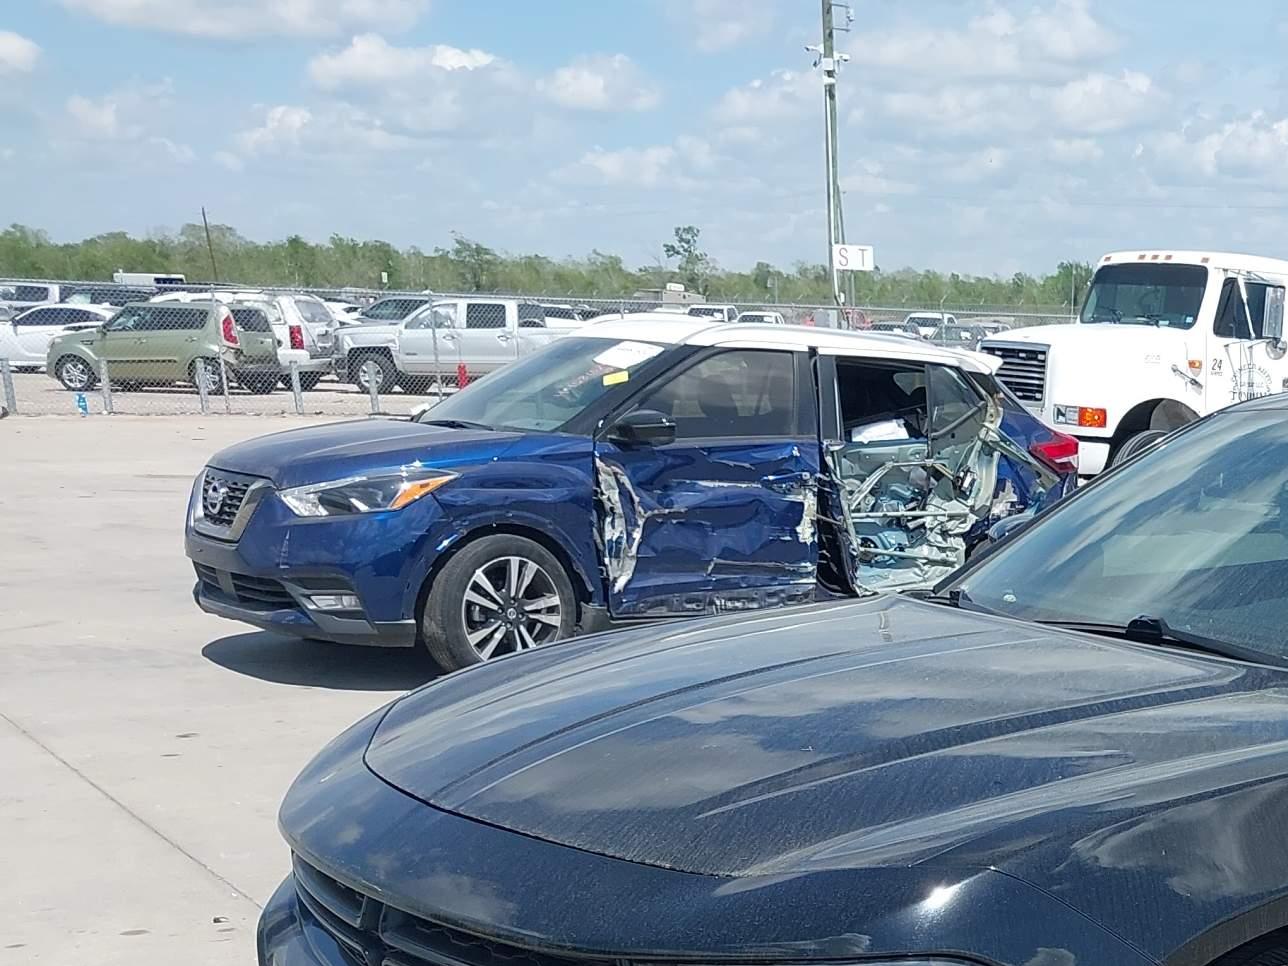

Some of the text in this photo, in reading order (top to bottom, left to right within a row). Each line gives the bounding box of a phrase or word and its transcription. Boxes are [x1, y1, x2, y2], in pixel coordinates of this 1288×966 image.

[838, 247, 869, 267] S T
[1212, 359, 1222, 370] 24
